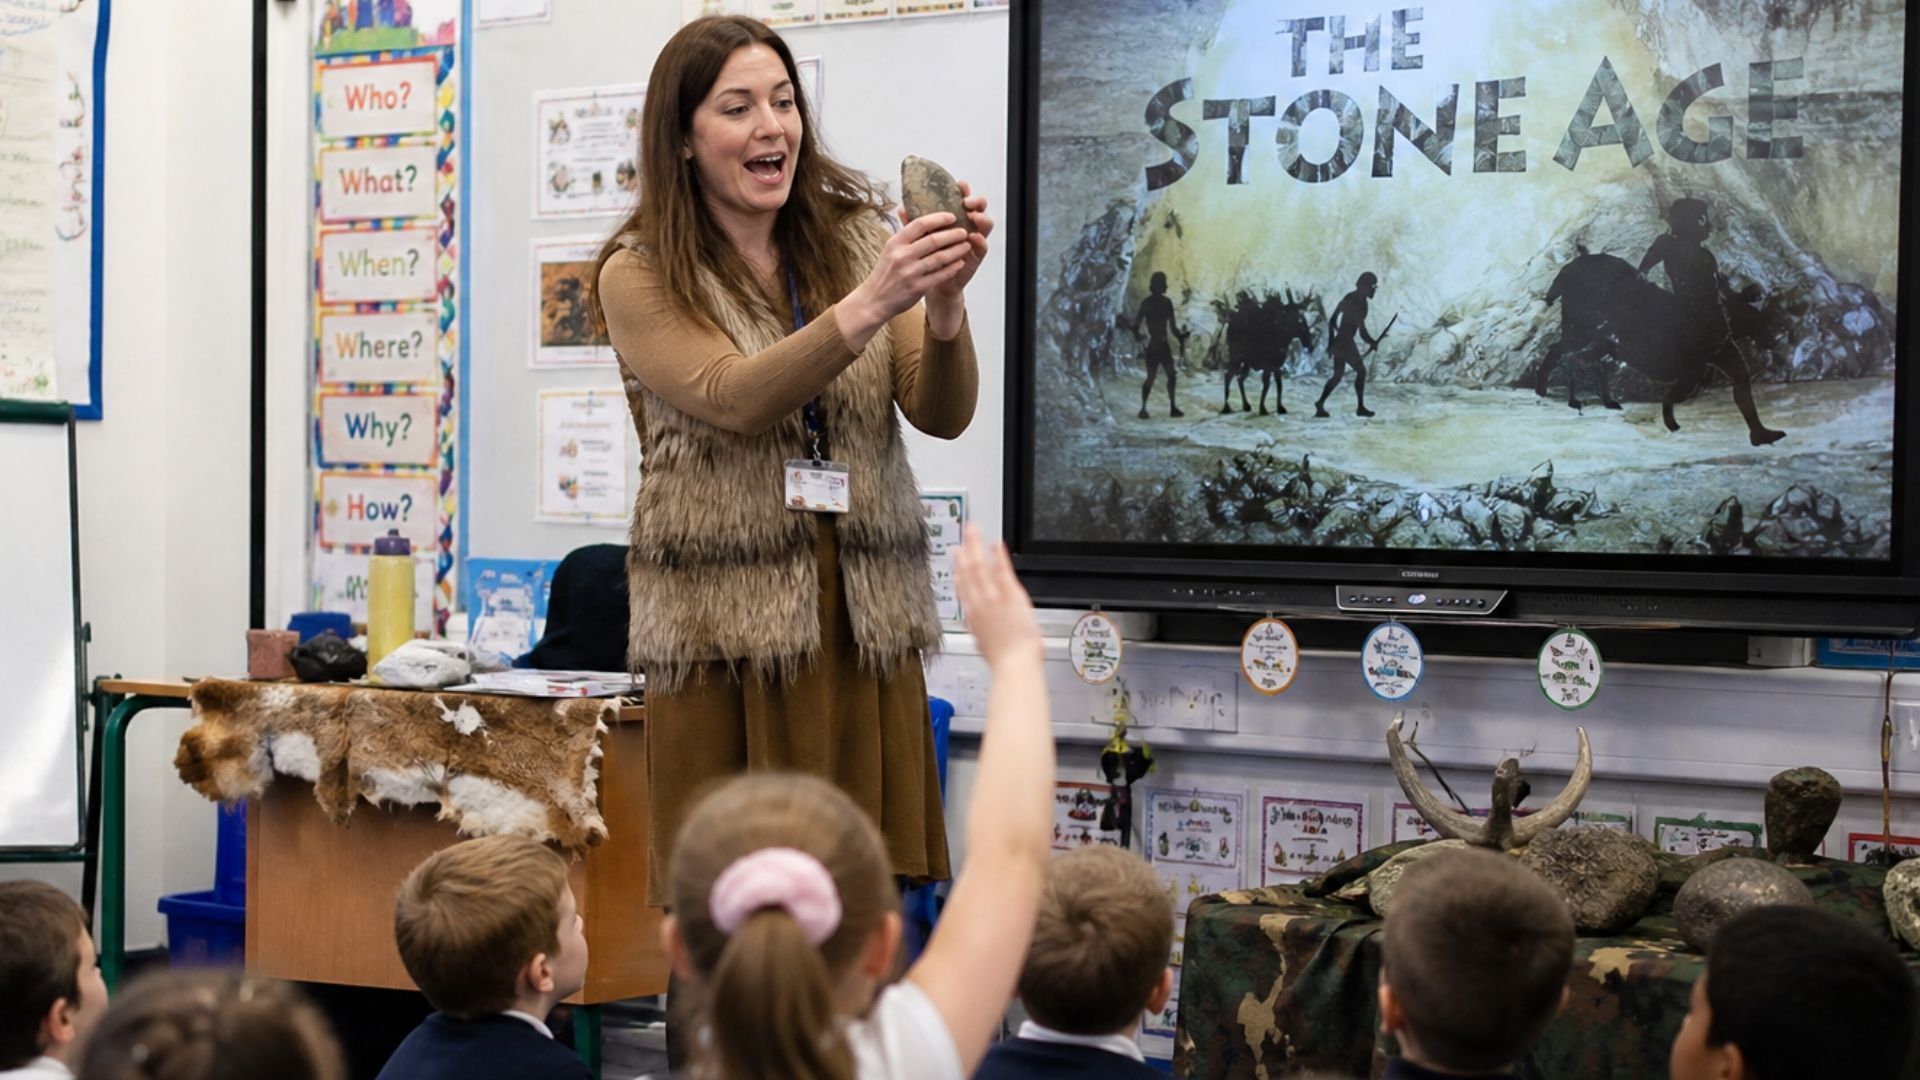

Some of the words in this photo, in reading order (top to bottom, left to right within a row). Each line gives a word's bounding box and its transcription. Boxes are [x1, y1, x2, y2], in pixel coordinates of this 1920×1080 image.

[1276, 7, 1423, 77] THE
[344, 81, 411, 111] Who?
[1145, 77, 1526, 191] STONE
[1552, 56, 1804, 172] AGE
[339, 165, 417, 194] What?
[338, 248, 419, 277] When?
[335, 330, 423, 358] Where?
[345, 412, 412, 447] Why?
[347, 494, 412, 522] How?
